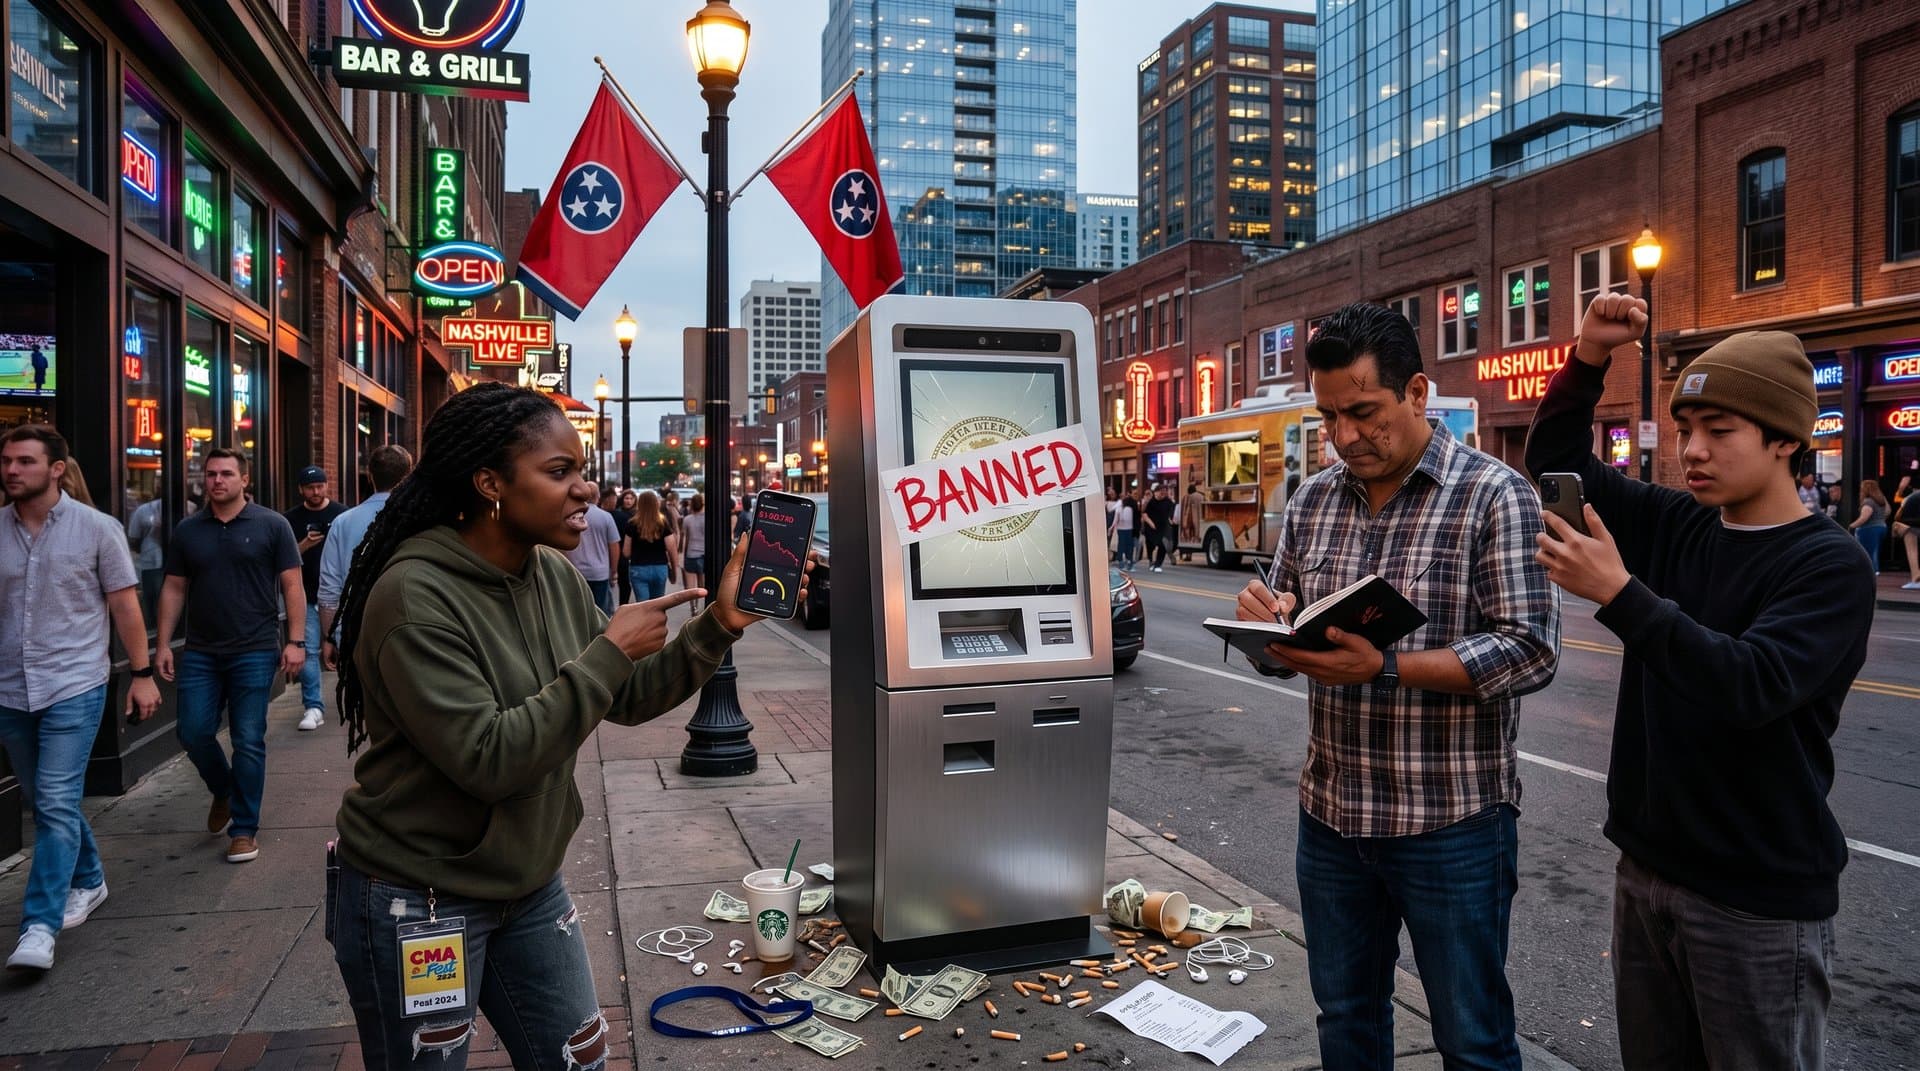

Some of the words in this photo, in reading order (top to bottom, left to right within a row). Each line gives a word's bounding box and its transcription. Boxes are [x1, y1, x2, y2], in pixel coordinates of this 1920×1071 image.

[341, 44, 401, 75] BAR
[409, 50, 431, 77] &
[439, 53, 522, 85] GRILL
[420, 257, 499, 286] OPEN
[448, 323, 548, 343] NASHVILLE
[478, 342, 518, 359] LIVE
[1508, 375, 1546, 401] LIVE
[894, 441, 1083, 533] BANNED
[410, 946, 456, 965] CMA
[426, 960, 458, 978] Fest
[434, 994, 458, 1005] 2024
